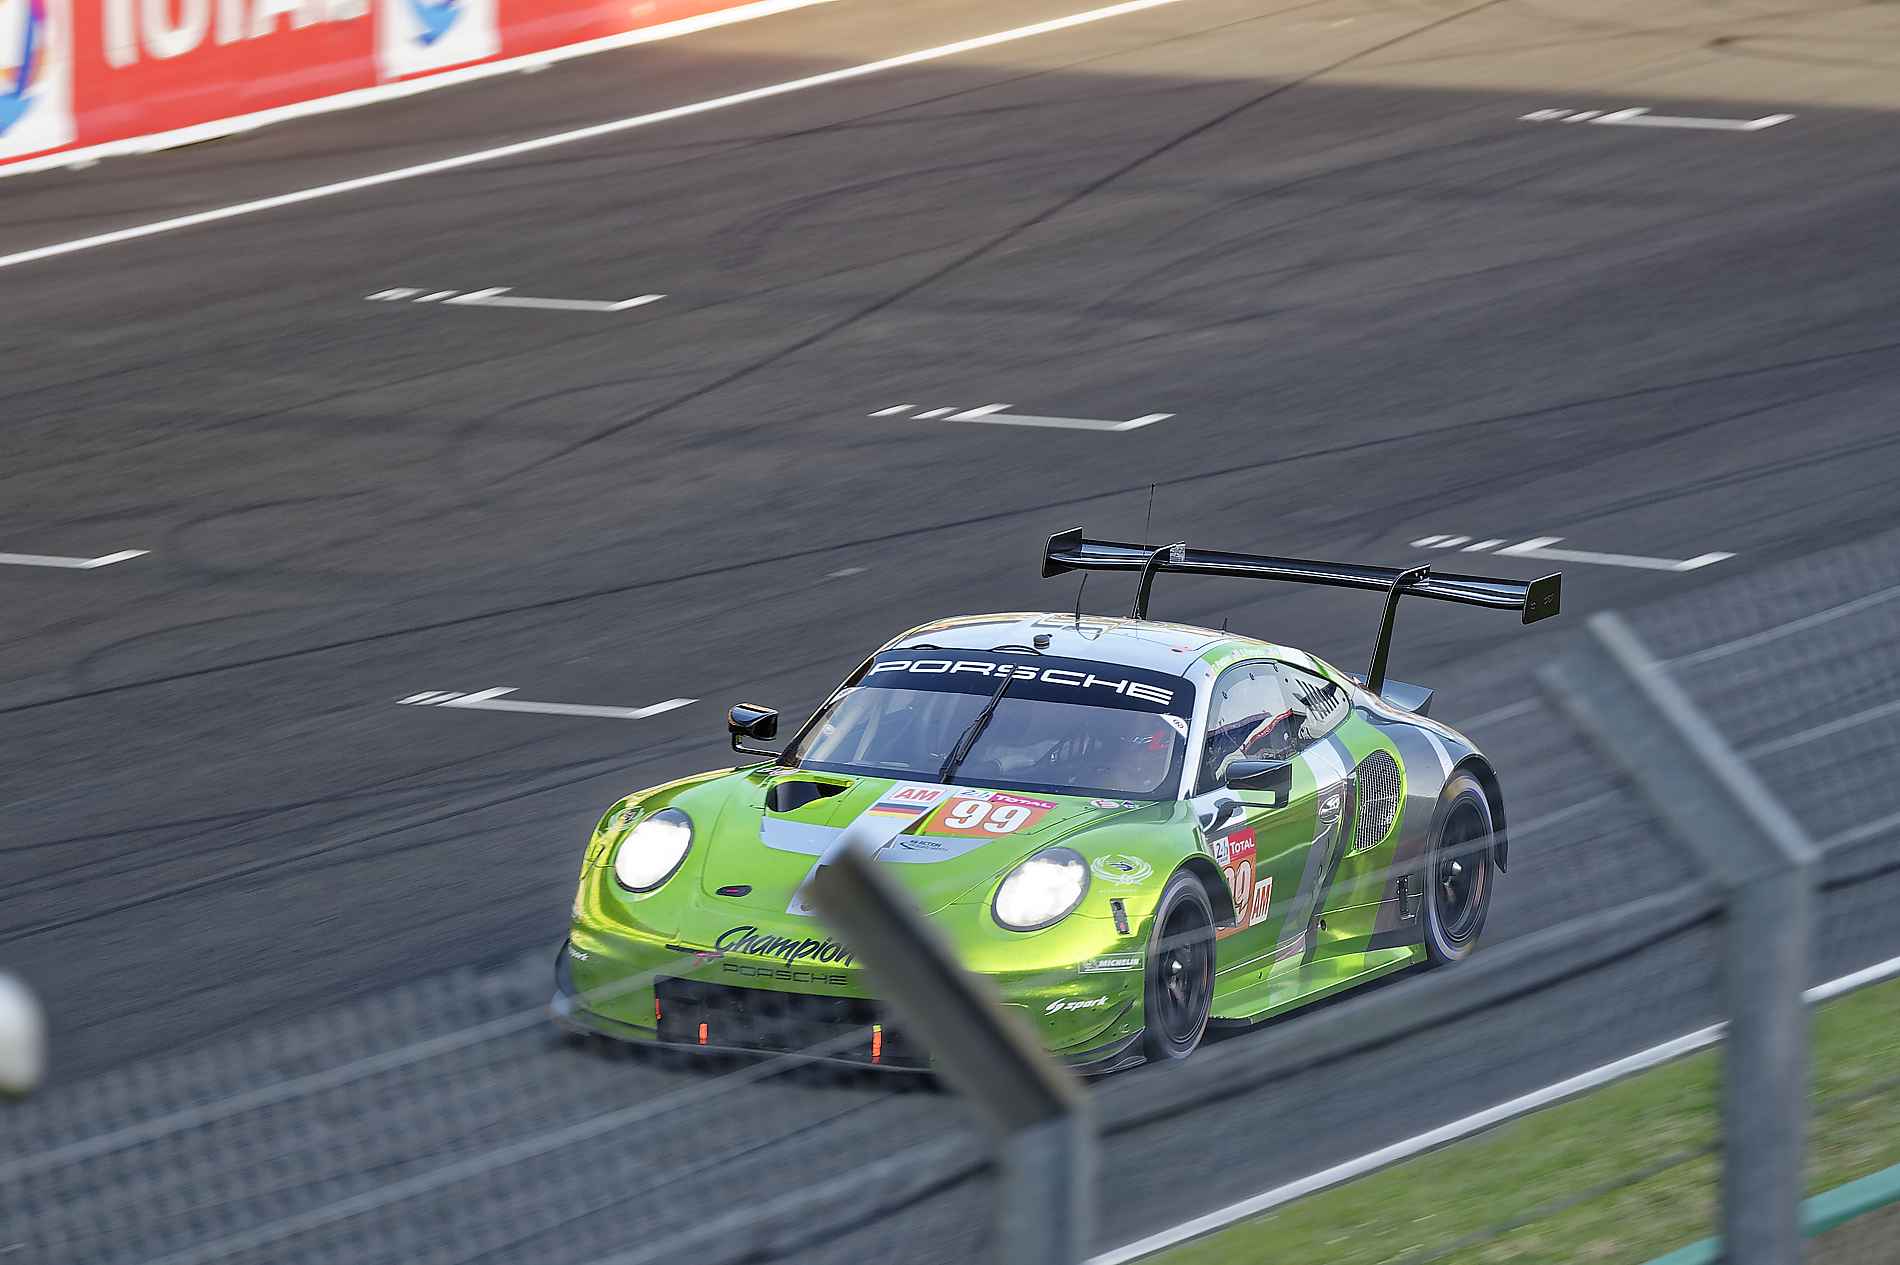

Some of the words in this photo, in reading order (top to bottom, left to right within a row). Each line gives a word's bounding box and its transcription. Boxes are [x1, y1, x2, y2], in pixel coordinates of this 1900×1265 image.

[868, 659, 1174, 706] PORSCHE
[894, 787, 941, 801] AM
[996, 793, 1053, 809] TOTAL
[944, 799, 1032, 833] 99
[1229, 837, 1255, 855] TOTAL
[1251, 883, 1271, 920] AM
[715, 925, 859, 968] Champion
[722, 963, 848, 986] PORSCHE
[1063, 995, 1109, 1011] spark
